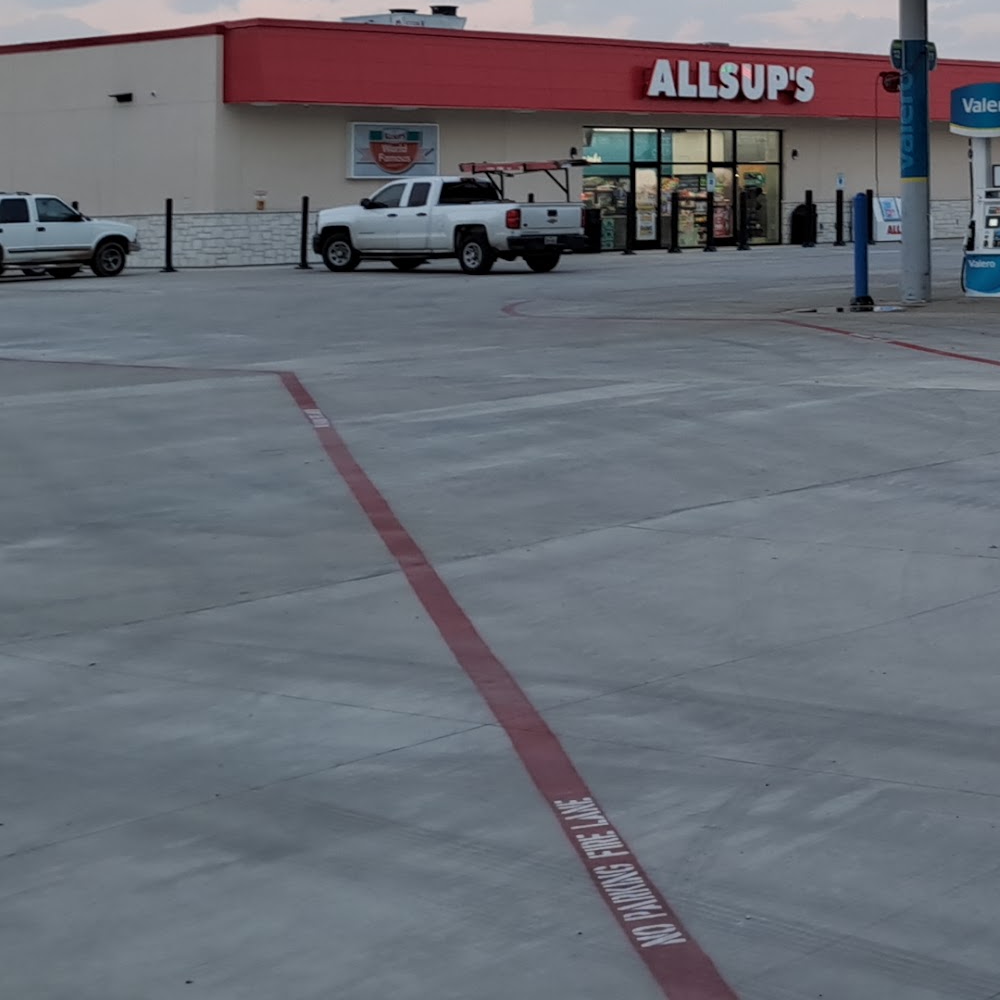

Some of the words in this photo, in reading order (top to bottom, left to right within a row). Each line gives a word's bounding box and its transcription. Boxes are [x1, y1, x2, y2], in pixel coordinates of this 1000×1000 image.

[646, 58, 816, 103] ALLSUP'S
[967, 259, 998, 269] Valero
[552, 796, 609, 831] LANE
[575, 829, 630, 860] FIRE
[591, 862, 668, 922] PARKING
[631, 923, 687, 948] NO
